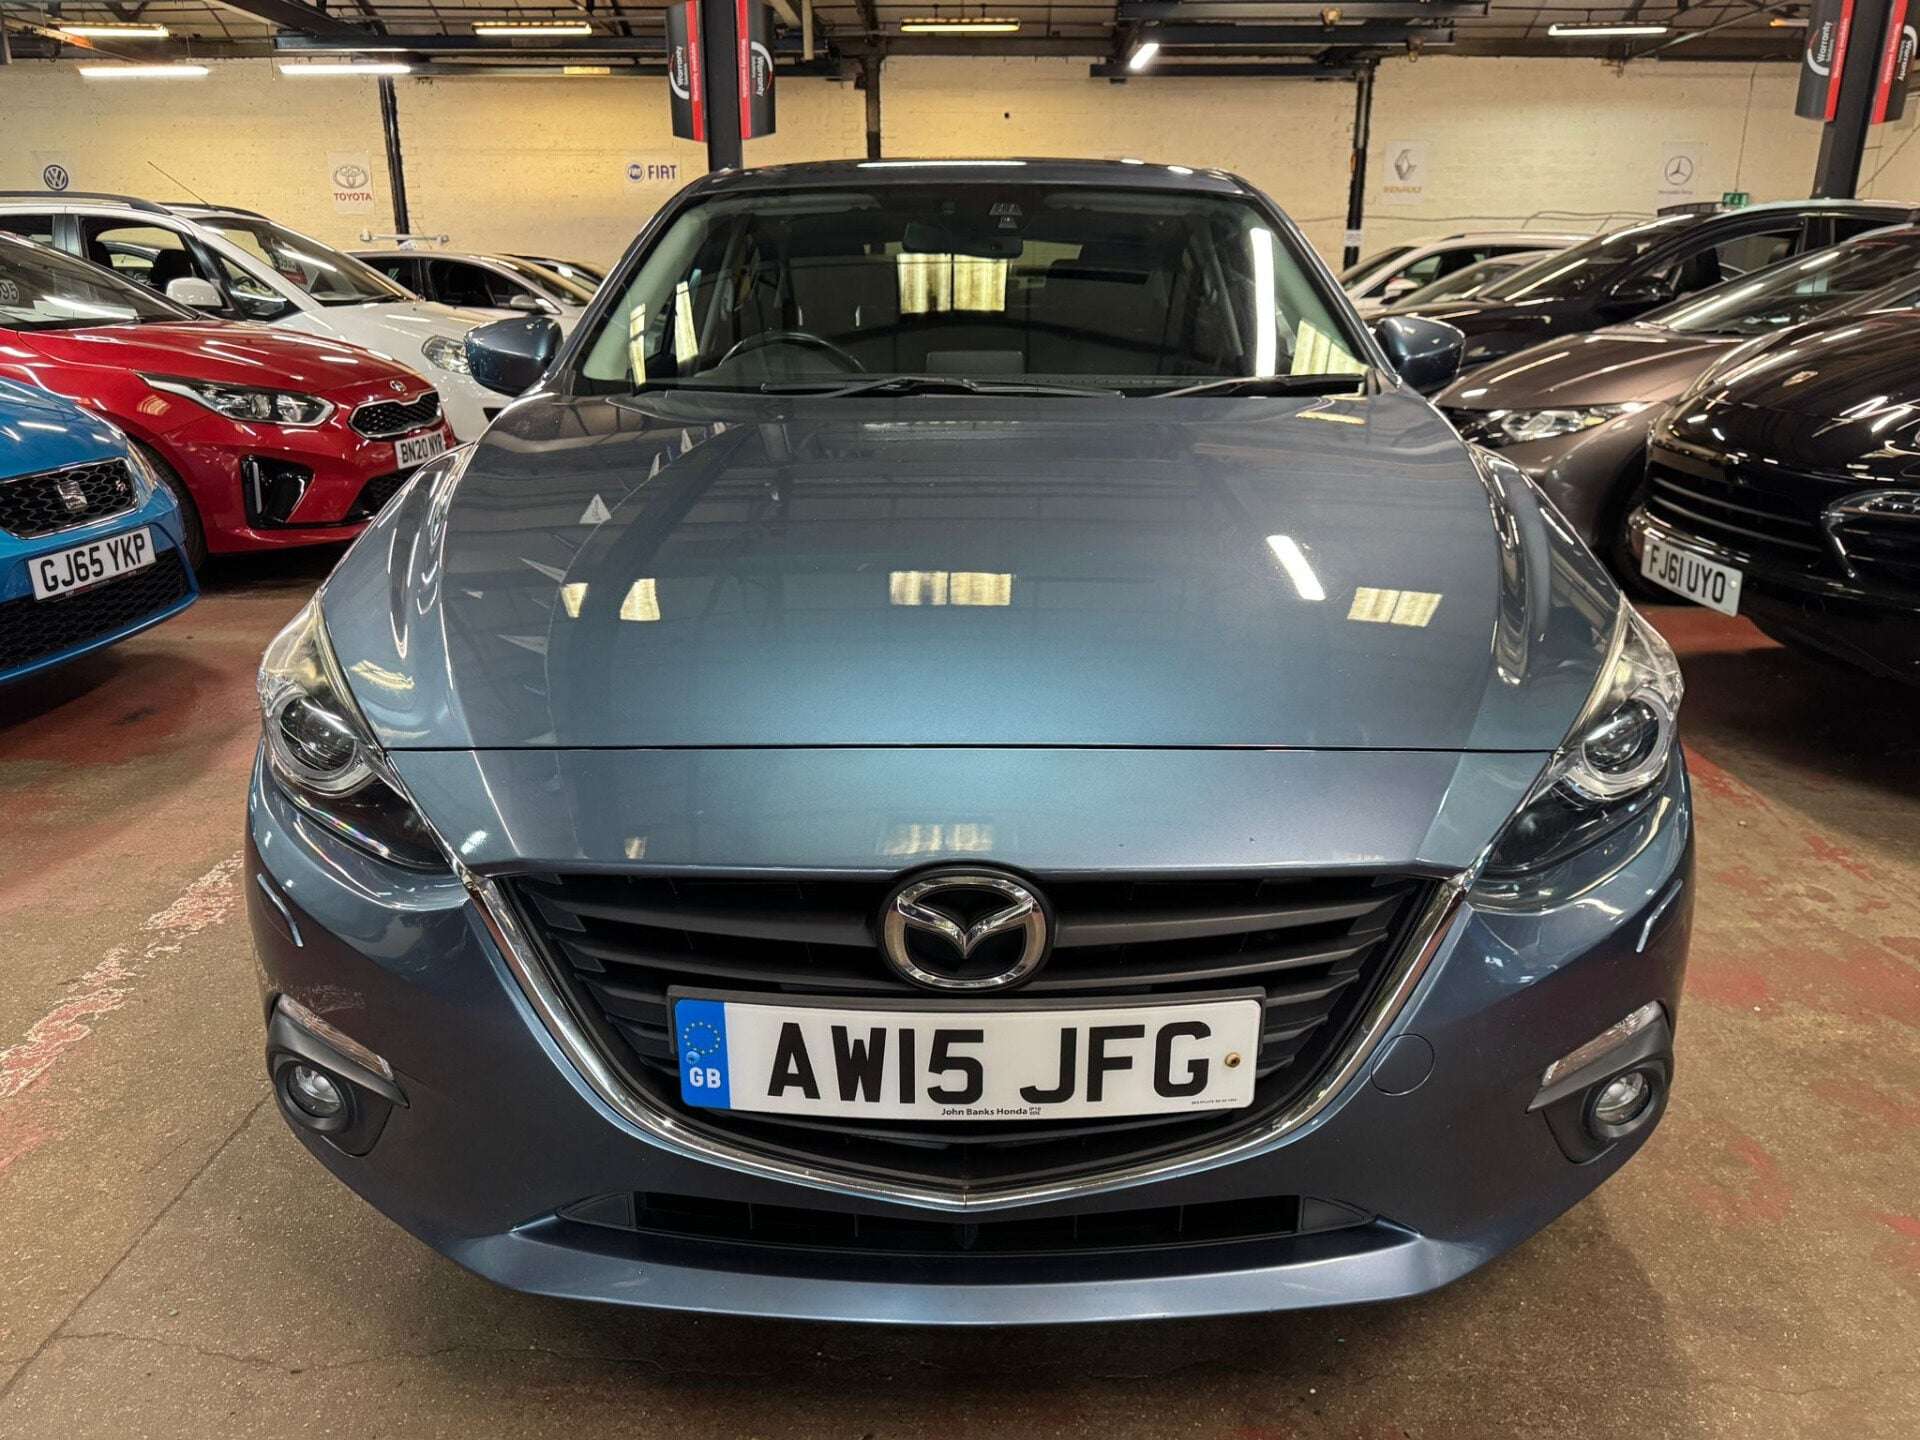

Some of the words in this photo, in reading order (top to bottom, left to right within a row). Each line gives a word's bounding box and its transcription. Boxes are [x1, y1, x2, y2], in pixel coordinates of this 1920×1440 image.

[1816, 21, 1833, 63] Warranty
[1897, 40, 1914, 82] Warranty
[675, 45, 684, 86] Warranty
[756, 55, 765, 97] Warranty
[647, 164, 677, 180] FIAT
[333, 192, 373, 201] TOYOTA
[400, 438, 429, 464] BN20
[40, 545, 104, 592] GJ65
[106, 533, 145, 571] YKP
[1648, 544, 1684, 588] FJ61
[1686, 560, 1726, 604] UYO
[689, 1066, 721, 1089] GB
[767, 1022, 984, 1105] AW15
[1019, 1020, 1212, 1105] JFG
[941, 1107, 964, 1116] John
[966, 1107, 995, 1116] Banks
[996, 1107, 1028, 1116] Honda
